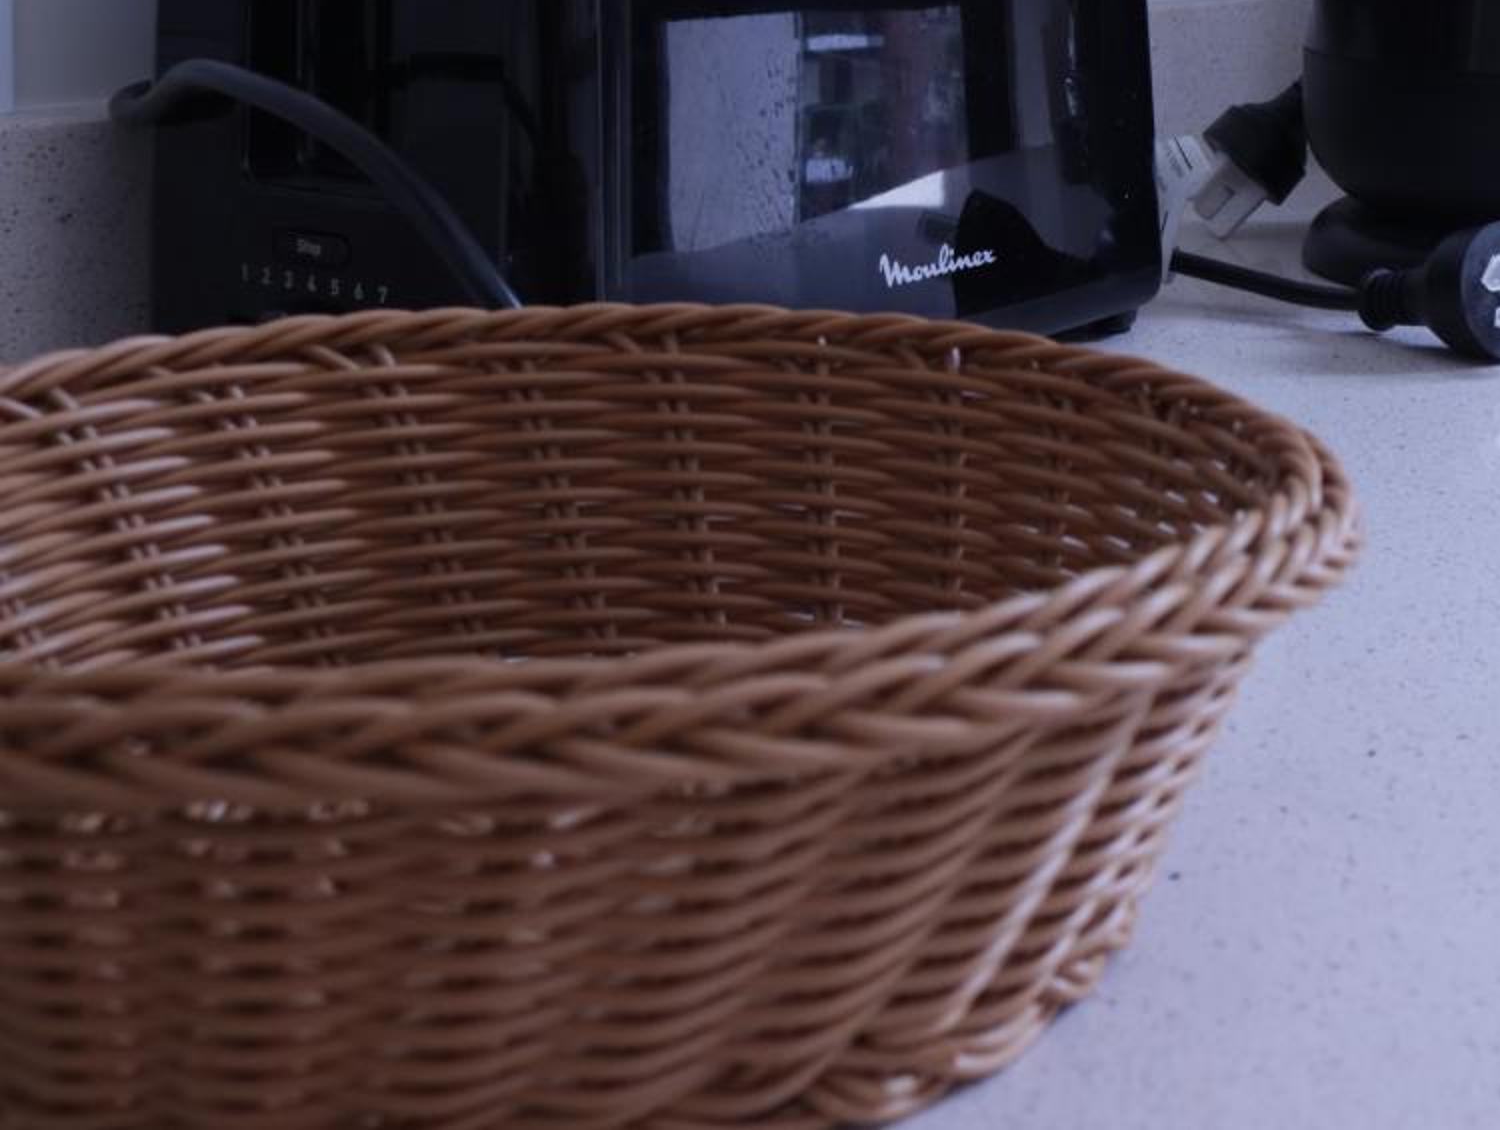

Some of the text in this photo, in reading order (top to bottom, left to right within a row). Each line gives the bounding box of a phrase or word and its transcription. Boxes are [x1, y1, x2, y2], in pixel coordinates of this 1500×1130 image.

[260, 266, 271, 285] 2
[377, 285, 388, 304] 7
[879, 243, 997, 288] Moulinex
